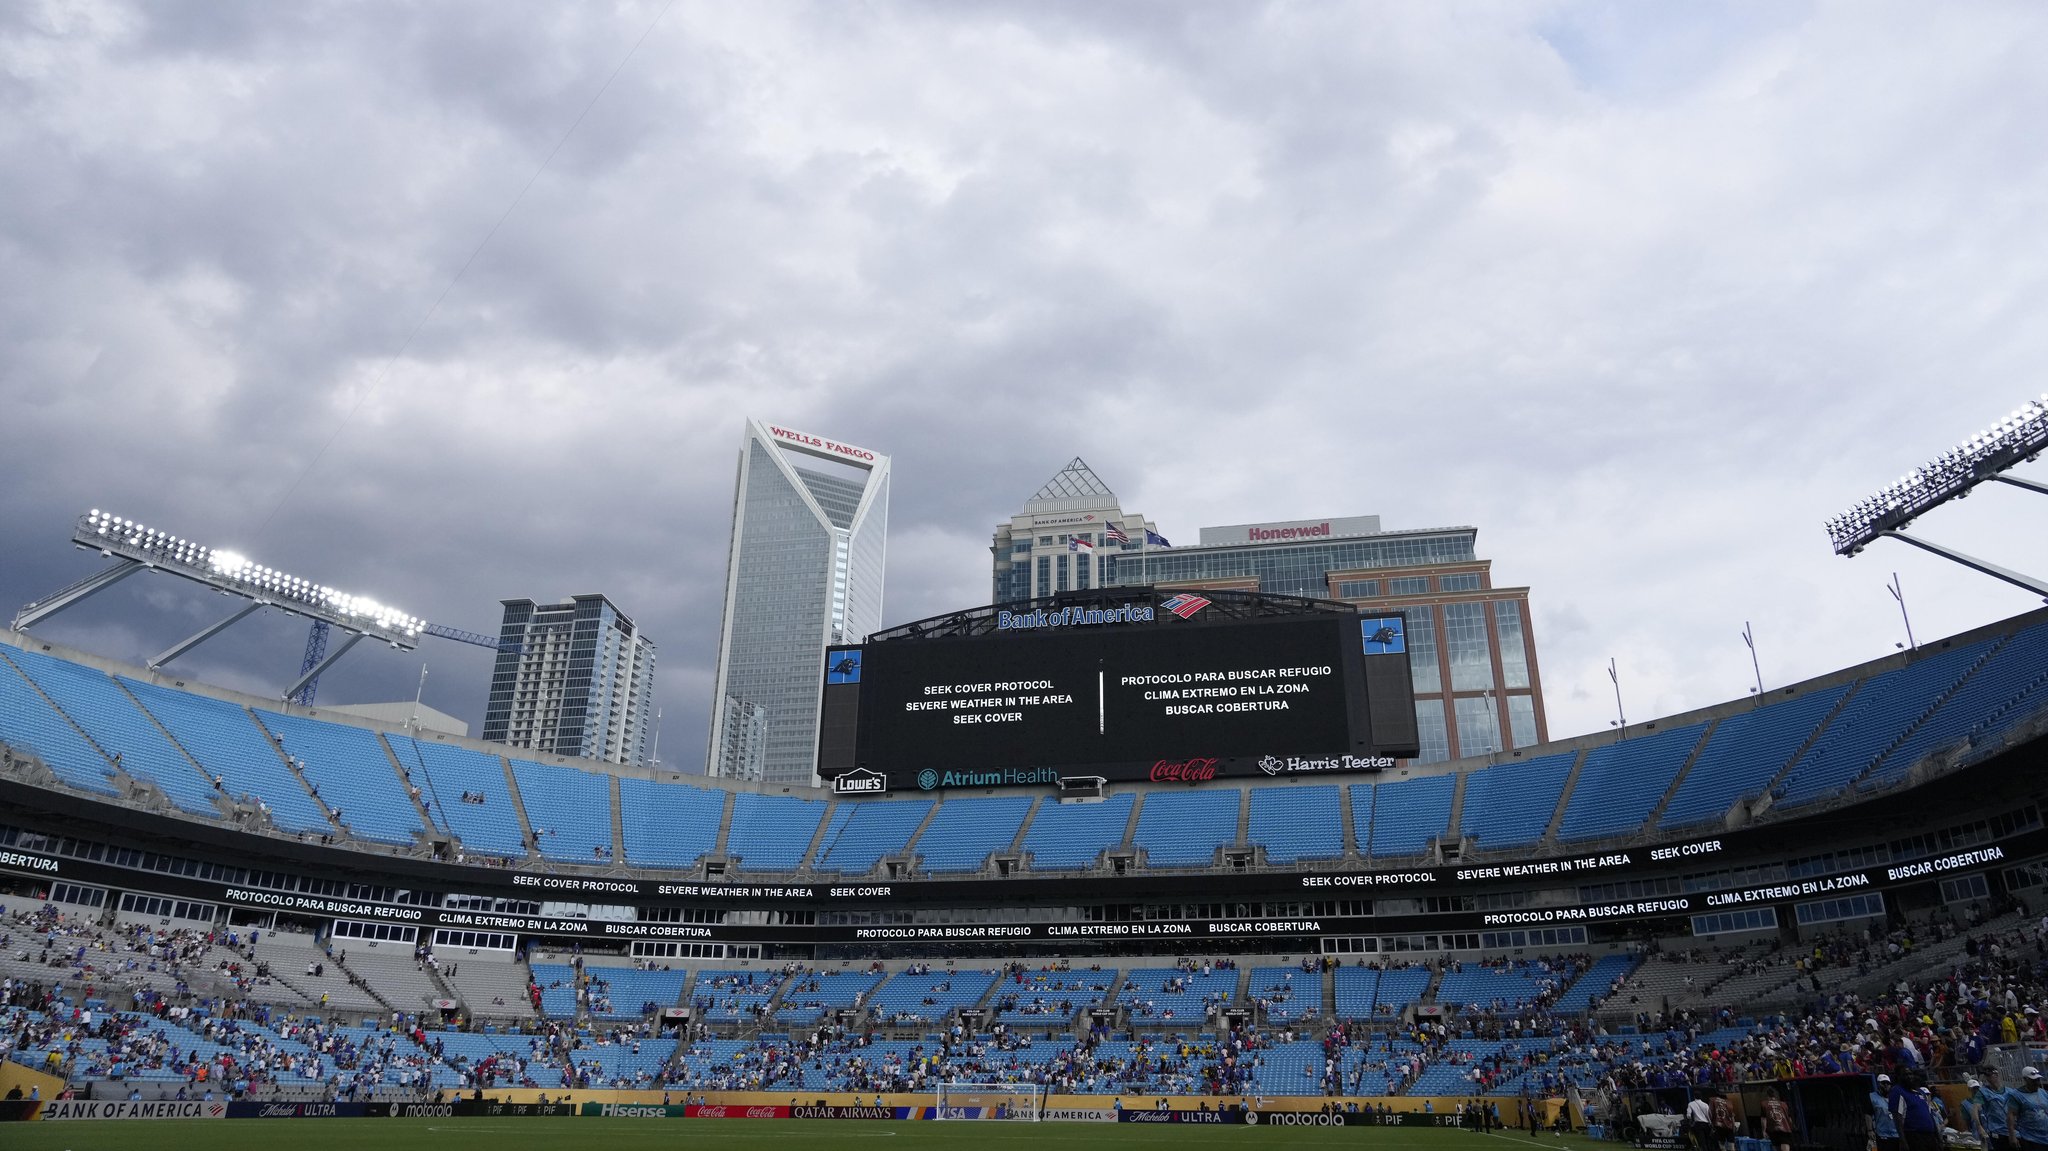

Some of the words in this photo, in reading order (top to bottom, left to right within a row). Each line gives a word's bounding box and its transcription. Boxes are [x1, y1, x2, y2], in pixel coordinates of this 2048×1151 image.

[770, 426, 822, 447] WELLS
[826, 441, 874, 461] FARGO
[1249, 522, 1330, 541] Honeywell
[998, 609, 1048, 630] Bank
[1049, 606, 1070, 626] of
[1071, 603, 1154, 625] America
[1122, 674, 1191, 685] PROTOCOLO
[1195, 672, 1225, 681] PARA
[1228, 669, 1276, 680] BUSCAR
[1280, 666, 1331, 677] REFUGIO
[924, 685, 952, 695] SEEK
[955, 683, 991, 693] COVER
[995, 680, 1054, 691] PROTOCOL
[1145, 690, 1179, 700] CLIMA
[1183, 687, 1237, 698] EXTREMO
[1241, 686, 1255, 695] EN
[1259, 685, 1274, 694] LA
[1277, 684, 1309, 693] ZONA
[906, 701, 947, 711] SEVERE
[950, 698, 1002, 708] WEATHER
[1006, 697, 1015, 706] IN
[1019, 696, 1040, 705] THE
[1043, 695, 1072, 704] AREA
[1166, 704, 1213, 715] BUSCAR
[1217, 701, 1289, 712] COBERTURA
[953, 714, 982, 724] SEEK
[985, 713, 1022, 722] COVER
[1286, 757, 1339, 771] Harris
[1341, 755, 1394, 769] Teeter
[941, 769, 1001, 786] Atrium
[1004, 767, 1058, 784] Health
[839, 778, 881, 791] LOWE'S
[1651, 847, 1680, 860] SEEK
[1683, 841, 1721, 855] COVER
[0, 853, 59, 872] BERTURA
[1457, 868, 1500, 879] SEVERE
[1503, 863, 1558, 876] WEATHER
[1561, 861, 1571, 871] IN
[1574, 858, 1596, 869] THE
[1599, 855, 1630, 866] AREA
[1888, 862, 1933, 880] BUSCAR
[1935, 847, 2003, 870] COBERTURA
[513, 876, 541, 886] SEEK
[544, 879, 579, 889] COVER
[583, 881, 638, 892] PROTOCOL
[1303, 877, 1331, 886] SEEK
[1334, 876, 1373, 885] COVER
[1376, 873, 1436, 884] PROTOCOL
[659, 886, 698, 895] SEVERE
[701, 887, 749, 896] WEATHER
[752, 888, 761, 896] IN
[831, 888, 855, 896] SEEK
[858, 887, 890, 896] COVER
[1707, 893, 1742, 905] CLIMA
[1744, 885, 1800, 901] EXTREMO
[1802, 882, 1817, 893] EN
[1820, 880, 1835, 890] LA
[1836, 874, 1869, 888] ZONA
[226, 889, 293, 905] PROTOCOLO
[296, 898, 324, 910] PARA
[327, 902, 371, 915] BUSCAR
[374, 907, 421, 919] REFUGIO
[1485, 911, 1553, 924] PROTOCOLO
[1556, 909, 1587, 919] PARA
[1589, 905, 1635, 917] BUSCAR
[1637, 899, 1688, 912] REFUGIO
[439, 914, 472, 924] CLIMA
[475, 916, 525, 927] EXTREMO
[528, 920, 541, 929] EN
[544, 922, 557, 930] LA
[559, 922, 587, 931] ZONA
[1048, 927, 1078, 935] CLIMA
[1081, 926, 1128, 934] EXTREMO
[1132, 925, 1144, 933] EN
[1148, 925, 1161, 933] LA
[1163, 925, 1191, 933] ZONA
[1209, 923, 1252, 932] BUSCAR
[1255, 922, 1320, 931] COBERTURA
[606, 925, 647, 934] BUSCAR
[650, 927, 711, 936] COBERTURA
[857, 929, 915, 937] PROTOCOLO
[946, 928, 985, 936] BUSCAR
[988, 927, 1031, 935] REFUGIO
[48, 1102, 100, 1119] BANK
[103, 1102, 126, 1118] OF
[128, 1102, 202, 1118] AMERICA
[304, 1103, 336, 1116] ULTRA
[404, 1102, 453, 1117] motorola
[493, 1104, 502, 1114] PIF
[518, 1104, 528, 1114] PIF
[544, 1104, 556, 1114] PIF
[601, 1103, 667, 1118] Hisense
[794, 1107, 835, 1119] QATAR
[839, 1107, 891, 1119] AIRWAYS
[938, 1107, 966, 1119] VISA
[1053, 1111, 1102, 1120] AMERICA
[1129, 1111, 1171, 1122] Michelob
[1181, 1112, 1221, 1123] ULTRA
[1269, 1111, 1345, 1126] motorola
[1385, 1115, 1403, 1125] PIF
[1445, 1115, 1463, 1126] PIF
